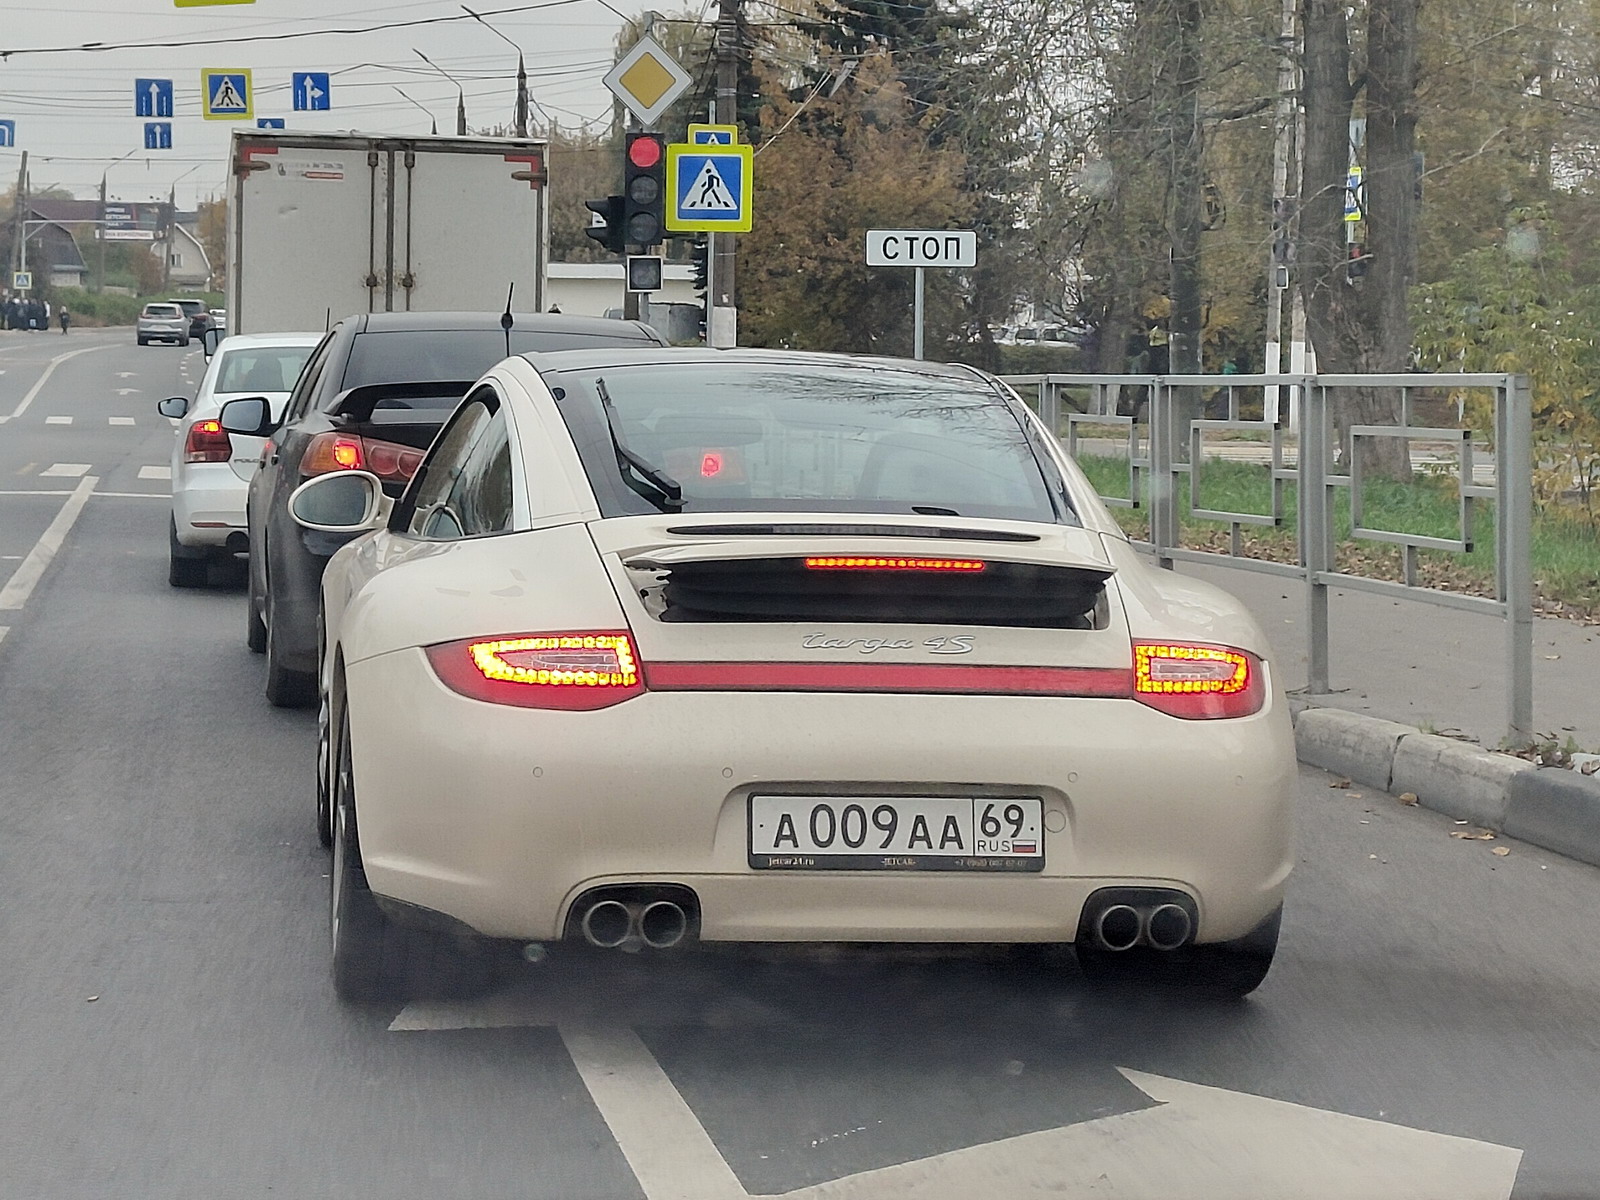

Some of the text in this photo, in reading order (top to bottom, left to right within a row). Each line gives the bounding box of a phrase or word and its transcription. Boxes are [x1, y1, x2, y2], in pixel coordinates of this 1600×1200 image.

[882, 236, 961, 260] СТОП
[802, 632, 976, 655] targa 4S
[981, 803, 1025, 838] 69
[977, 840, 1011, 852] RUS
